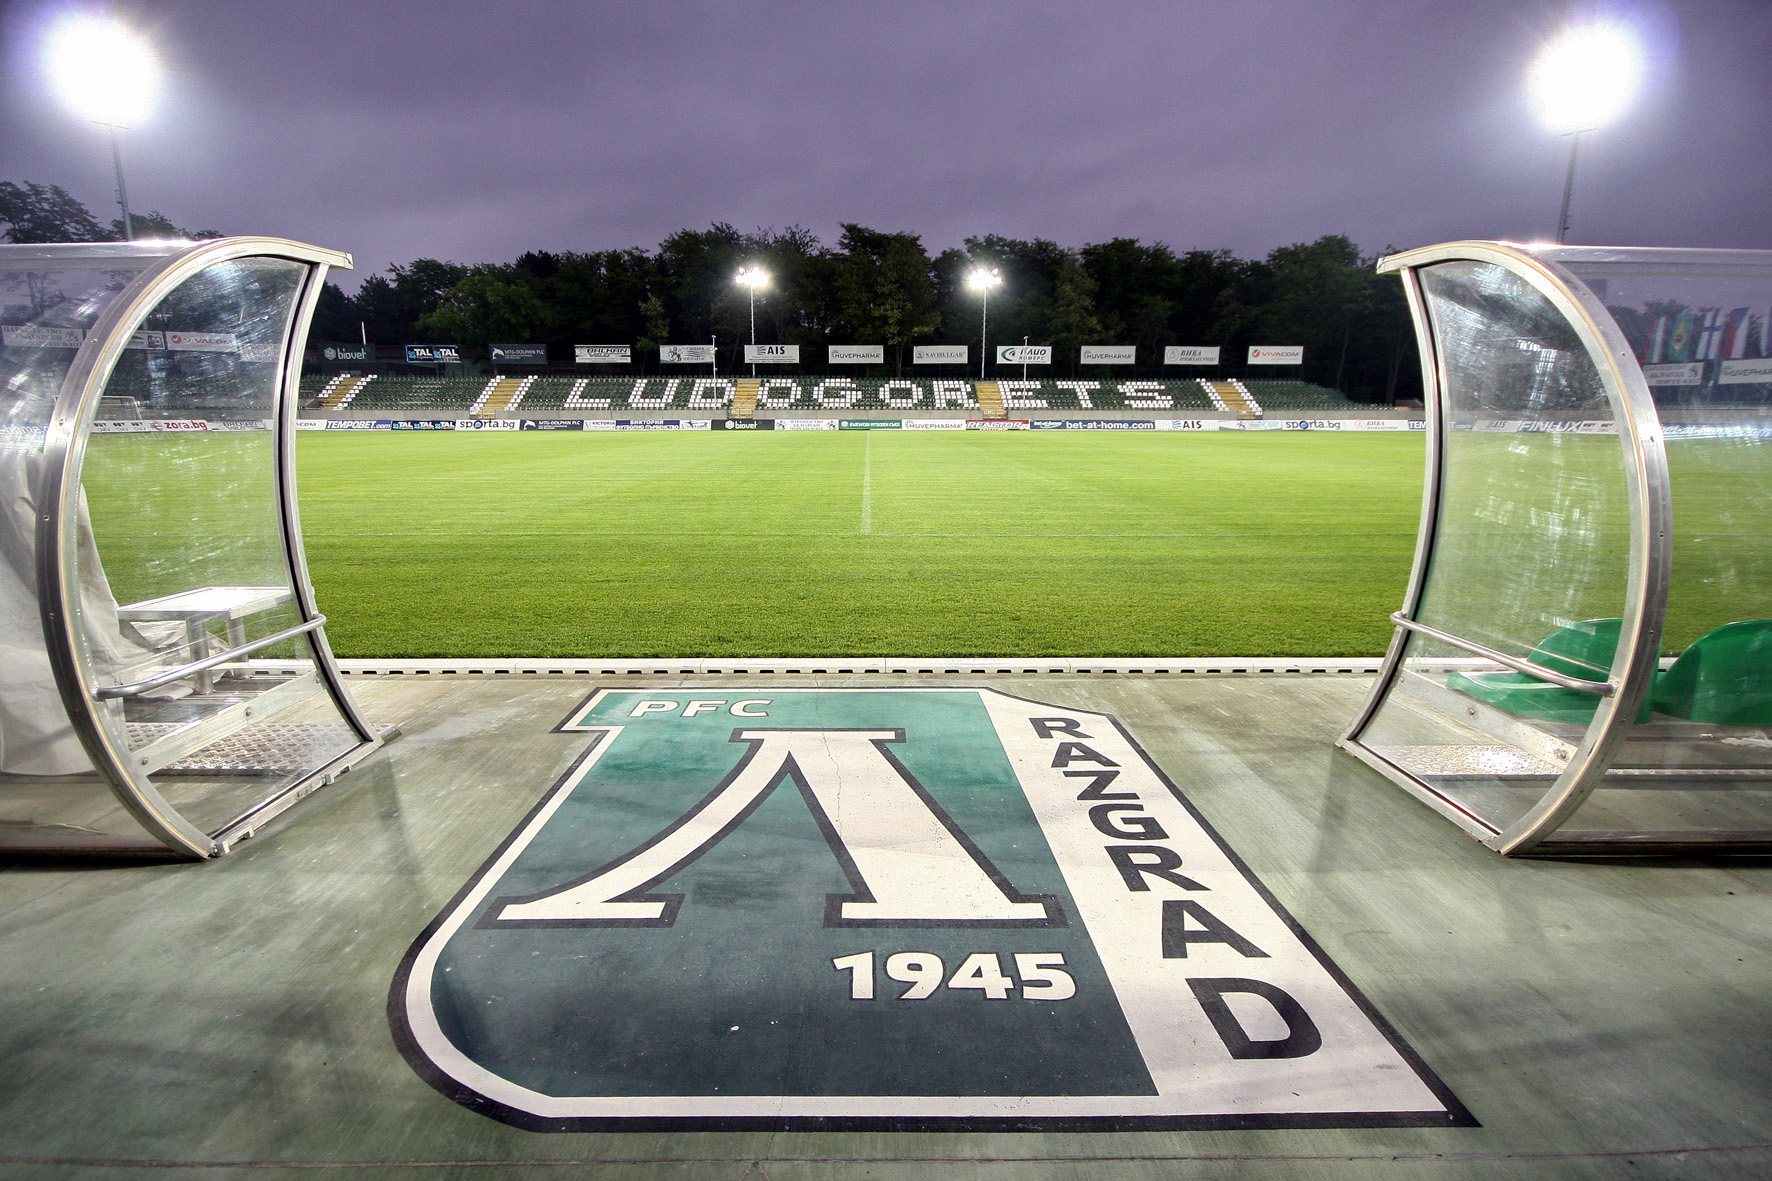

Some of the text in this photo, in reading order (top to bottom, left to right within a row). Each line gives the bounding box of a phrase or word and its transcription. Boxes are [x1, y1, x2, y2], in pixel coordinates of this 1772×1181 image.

[337, 347, 366, 360] biovet
[414, 348, 433, 357] TAL
[440, 348, 459, 357] TAL
[767, 345, 786, 355] AIS
[164, 420, 208, 430] zora.bg
[326, 420, 391, 429] TEMPOBET.com
[459, 420, 515, 429] sporta.bg
[735, 420, 758, 429] biovet
[1065, 420, 1154, 429] bet-at-home.com
[1182, 420, 1202, 429] AIS
[1285, 420, 1341, 430] sporta.bg
[1518, 420, 1582, 432] FINLUX
[628, 700, 774, 717] PFC
[1028, 717, 1323, 1060] RAZGRAD
[831, 951, 1078, 1001] 1945
